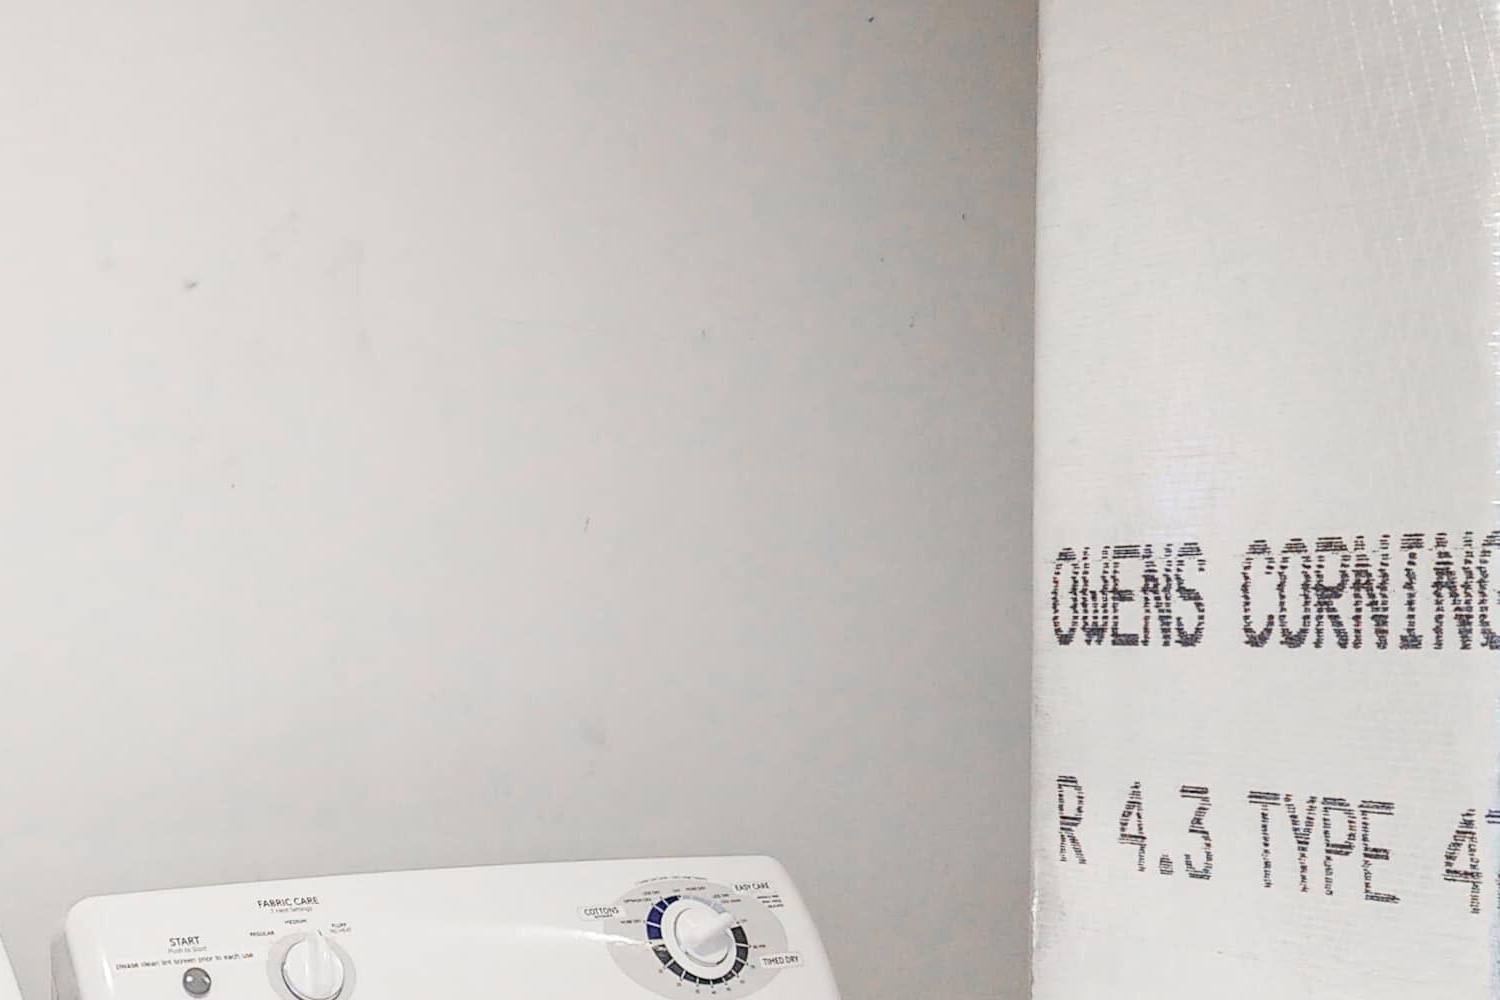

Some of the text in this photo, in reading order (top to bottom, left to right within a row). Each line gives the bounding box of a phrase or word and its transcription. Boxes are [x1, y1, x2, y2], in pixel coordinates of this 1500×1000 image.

[1052, 541, 1207, 648] OWENS
[1056, 775, 1087, 865] R
[1117, 780, 1214, 882] 4.3
[1247, 790, 1402, 905] TYPE
[734, 881, 771, 892] EASY CARE
[257, 896, 320, 908] FABRIC CARE
[583, 906, 620, 916] COTTONS
[168, 935, 201, 947] START
[761, 955, 799, 966] TIMED DRY
